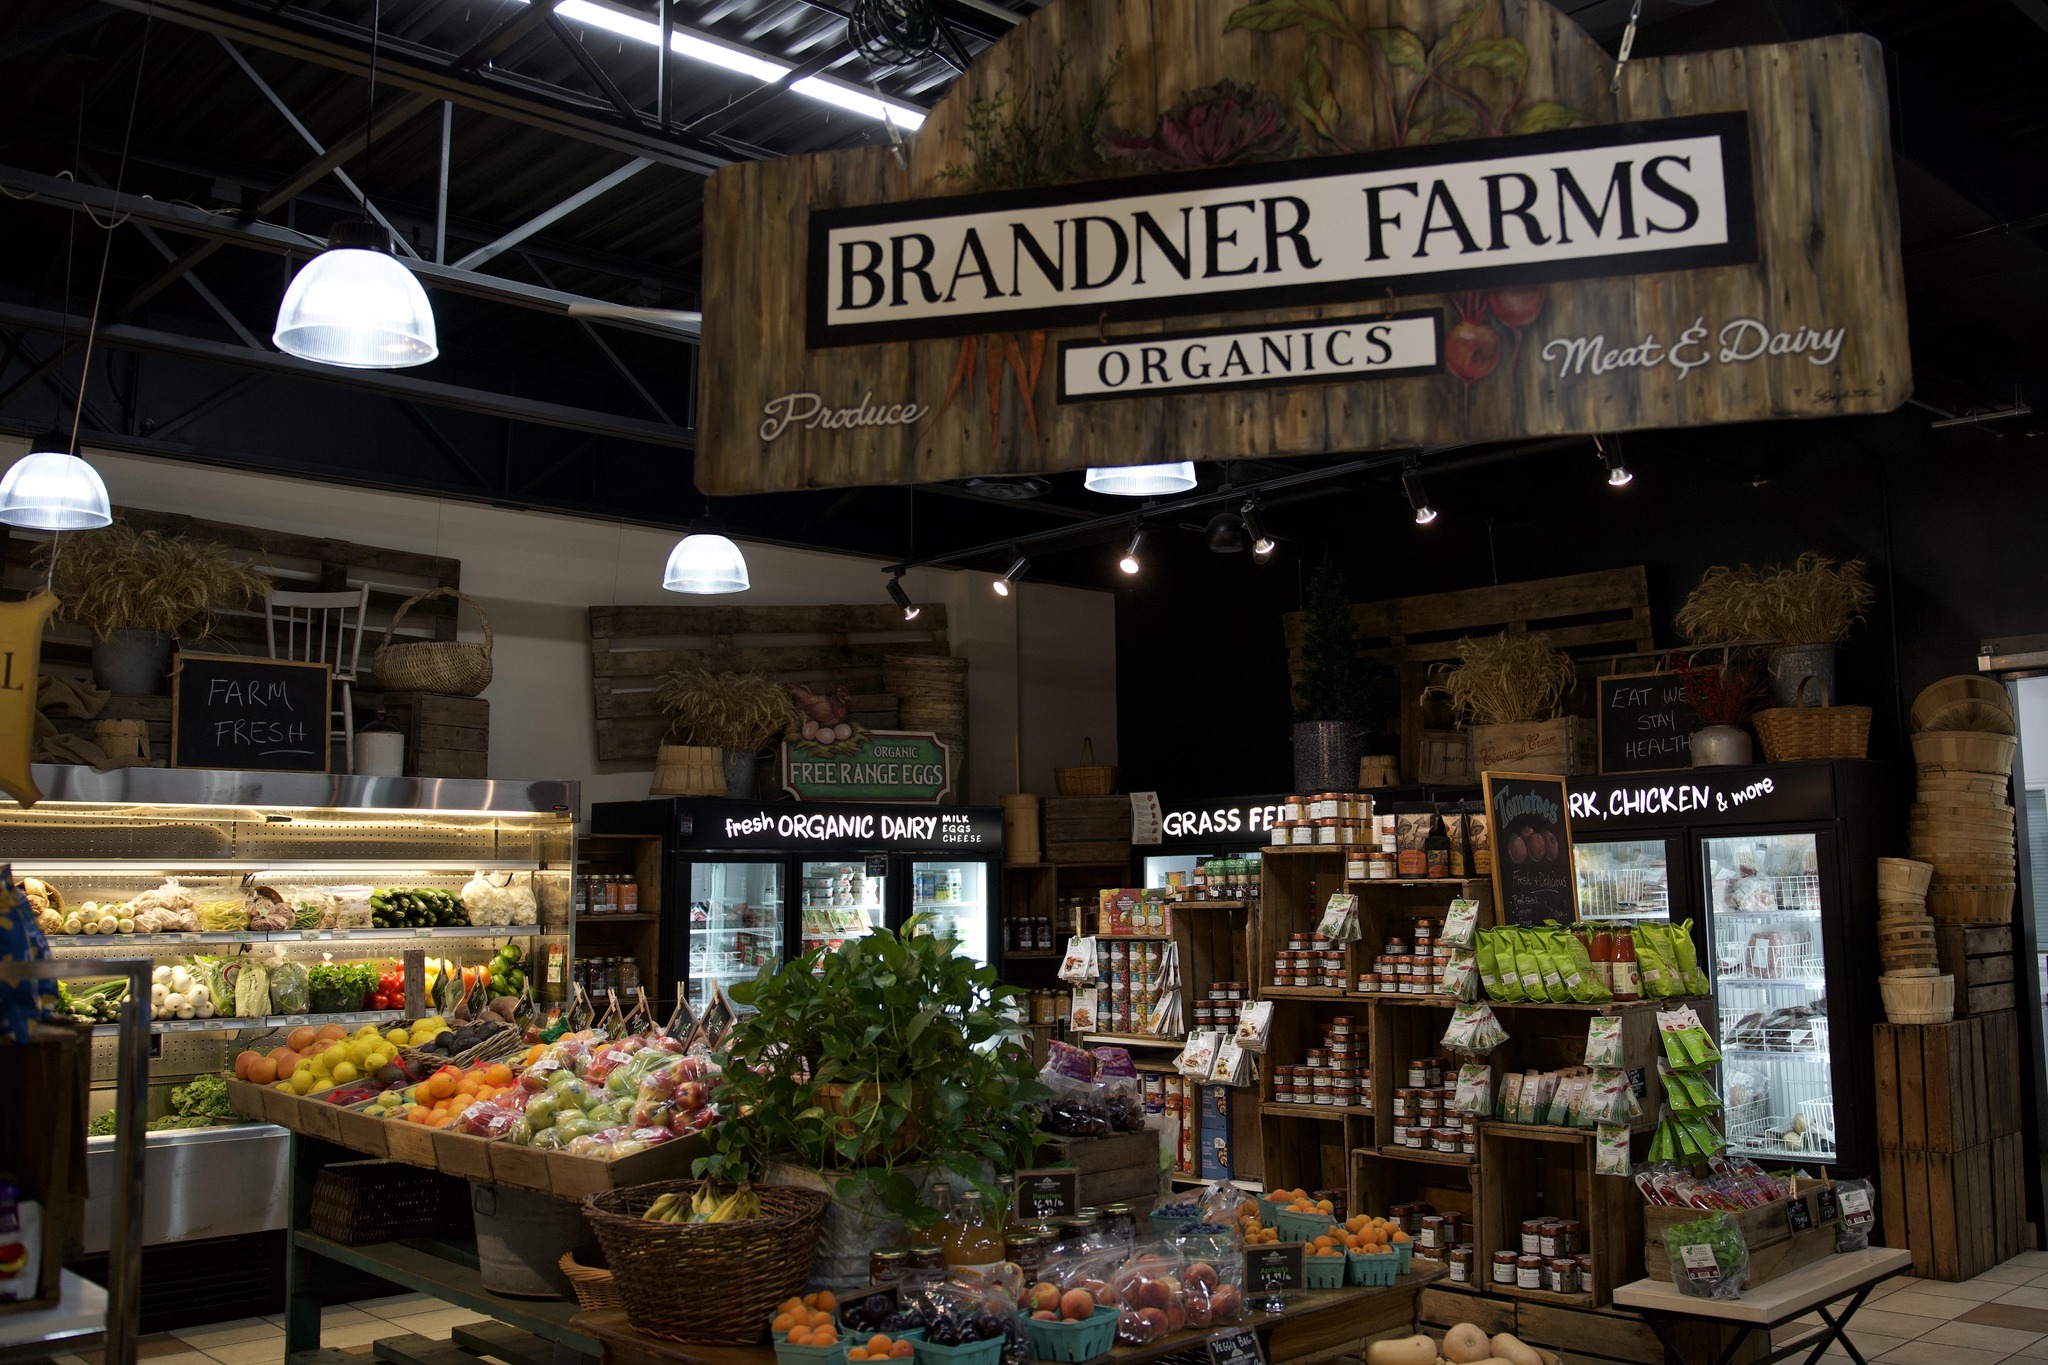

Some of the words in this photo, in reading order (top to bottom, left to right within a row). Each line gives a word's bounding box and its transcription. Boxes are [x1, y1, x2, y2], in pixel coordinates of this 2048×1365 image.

[836, 195, 1322, 310] BRANDNER
[1362, 155, 1700, 262] FARMS
[1098, 325, 1394, 388] ORGANICS
[1542, 334, 1665, 378] Meat
[1668, 317, 1711, 380] &
[1719, 319, 1846, 366] Dairy
[759, 391, 930, 441] Produce
[208, 678, 294, 712] FARM
[1611, 687, 1653, 709] EAT
[214, 719, 307, 747] FRESH
[1637, 710, 1675, 732] STAY
[874, 746, 918, 758] ORGANIC
[1625, 735, 1692, 759] HEALTH
[790, 762, 837, 784] FREE
[840, 763, 899, 785] RANGE
[902, 764, 943, 785] EGGS
[1494, 785, 1559, 829] Tomatoes
[1567, 791, 1608, 821] RK,
[1609, 785, 1710, 816] CHICKEN
[1716, 792, 1729, 812] &
[1731, 777, 1775, 806] more
[725, 811, 774, 839] fresh
[777, 814, 874, 841] ORGANIC
[881, 815, 938, 841] DAIRY
[942, 814, 970, 823] MILK
[942, 824, 971, 833] EGGS
[1163, 808, 1241, 837] GRASS
[942, 834, 982, 843] CHEESE
[1512, 870, 1532, 886] Fresh
[1260, 1266, 1288, 1274] Apricots
[1212, 1340, 1237, 1353] VEGGIE
